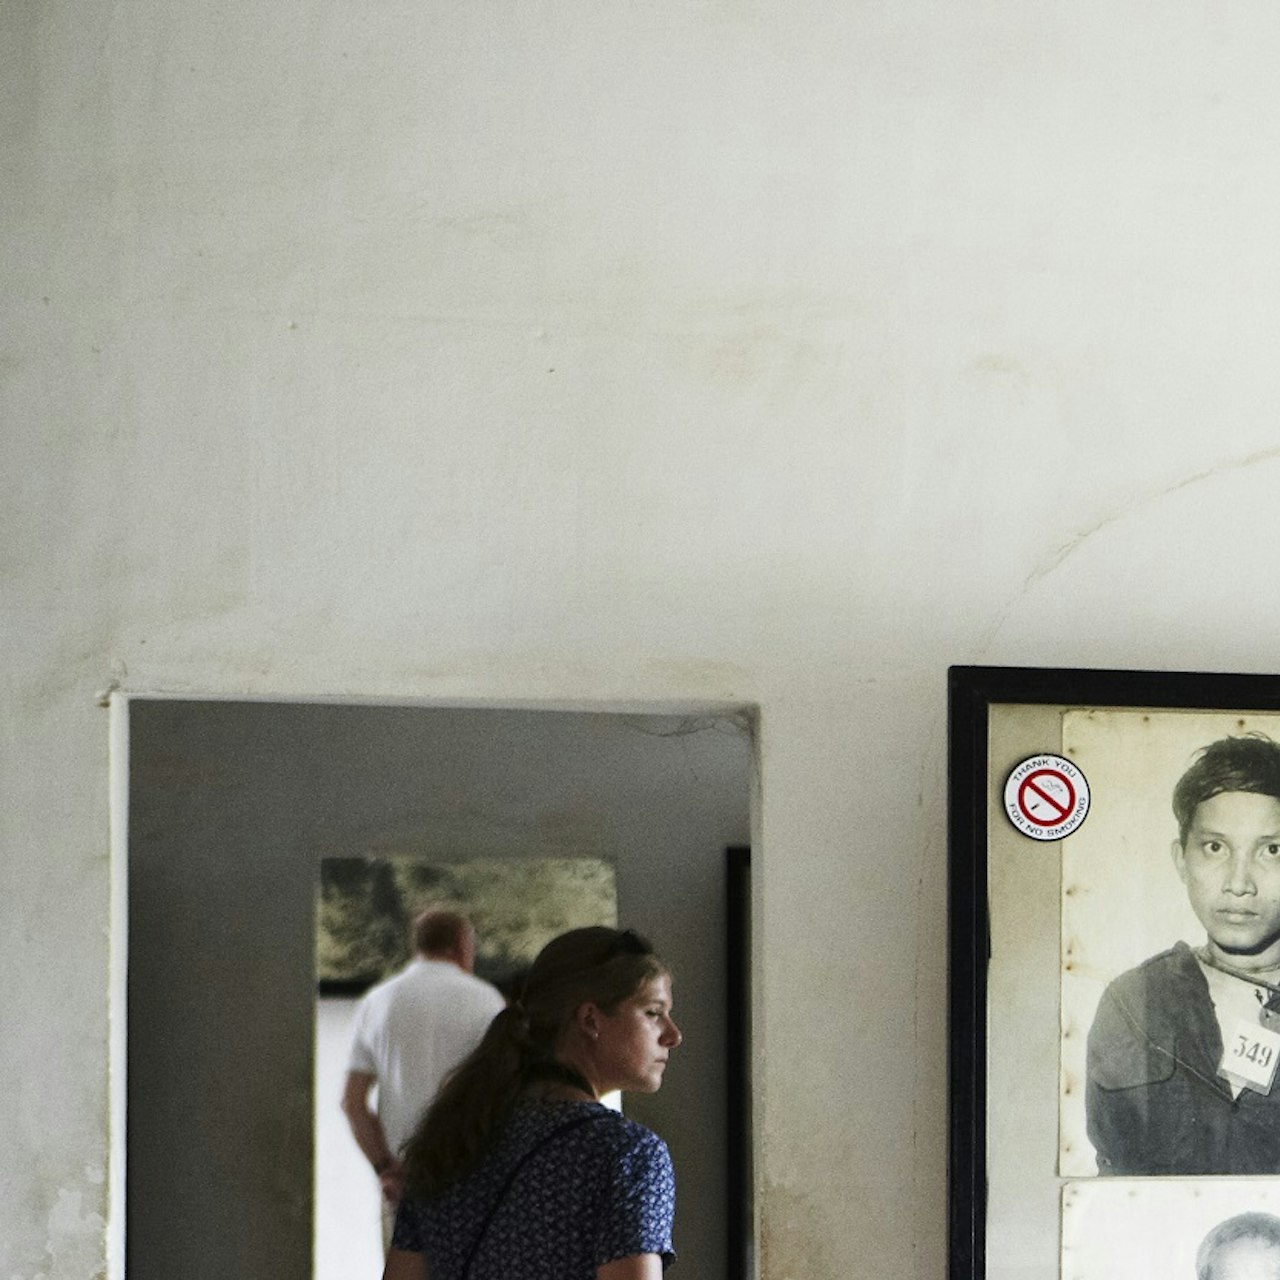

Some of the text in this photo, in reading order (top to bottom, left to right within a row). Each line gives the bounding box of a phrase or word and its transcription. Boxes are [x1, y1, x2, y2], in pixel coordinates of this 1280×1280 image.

[1013, 758, 1077, 781] THANK YOU
[1009, 797, 1087, 837] FOR NO SMOKING
[1232, 1034, 1273, 1068] 349
